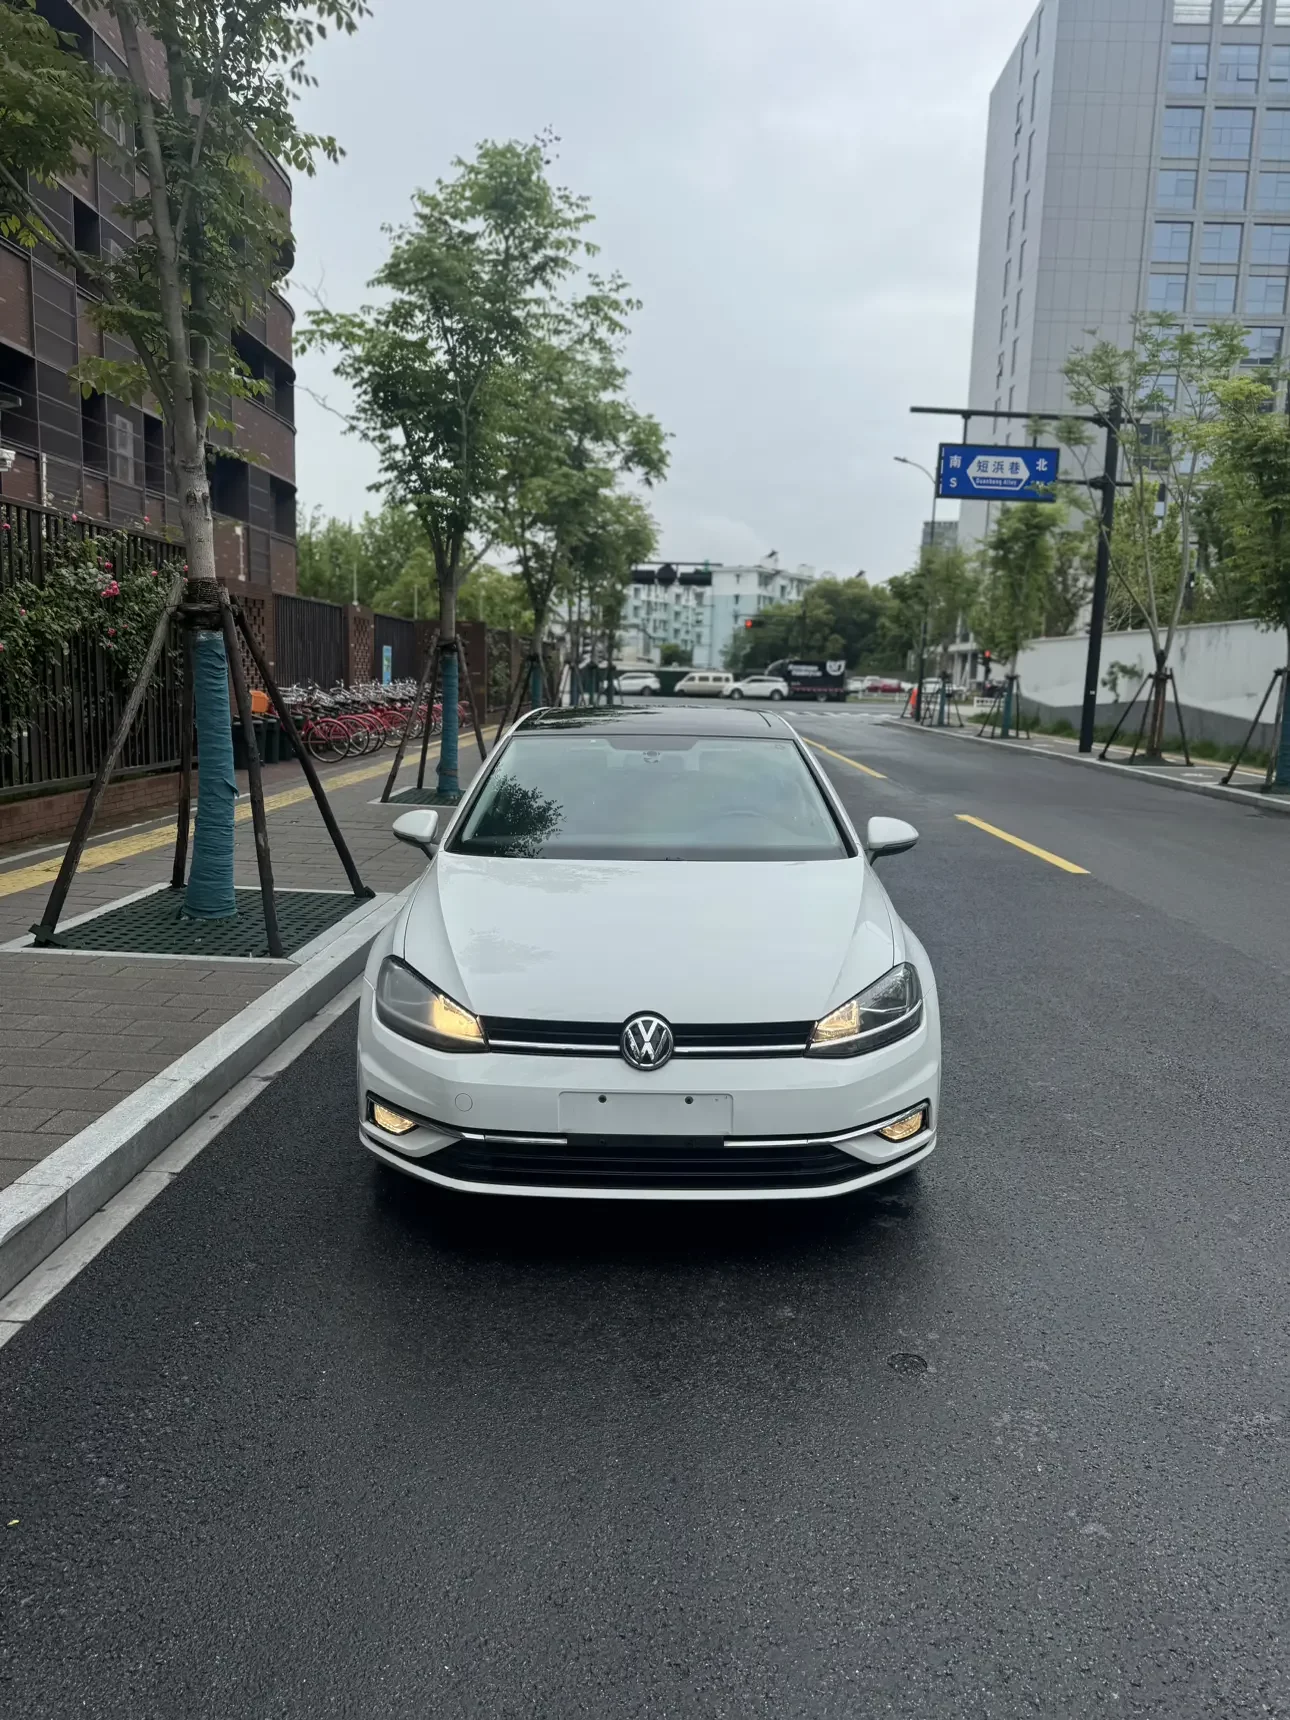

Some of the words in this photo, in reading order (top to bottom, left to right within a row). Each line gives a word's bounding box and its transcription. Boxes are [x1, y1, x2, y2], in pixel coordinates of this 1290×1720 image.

[949, 455, 961, 468] 南
[976, 460, 1020, 474] 短浜巷
[1036, 458, 1048, 471] 北
[950, 477, 957, 488] S
